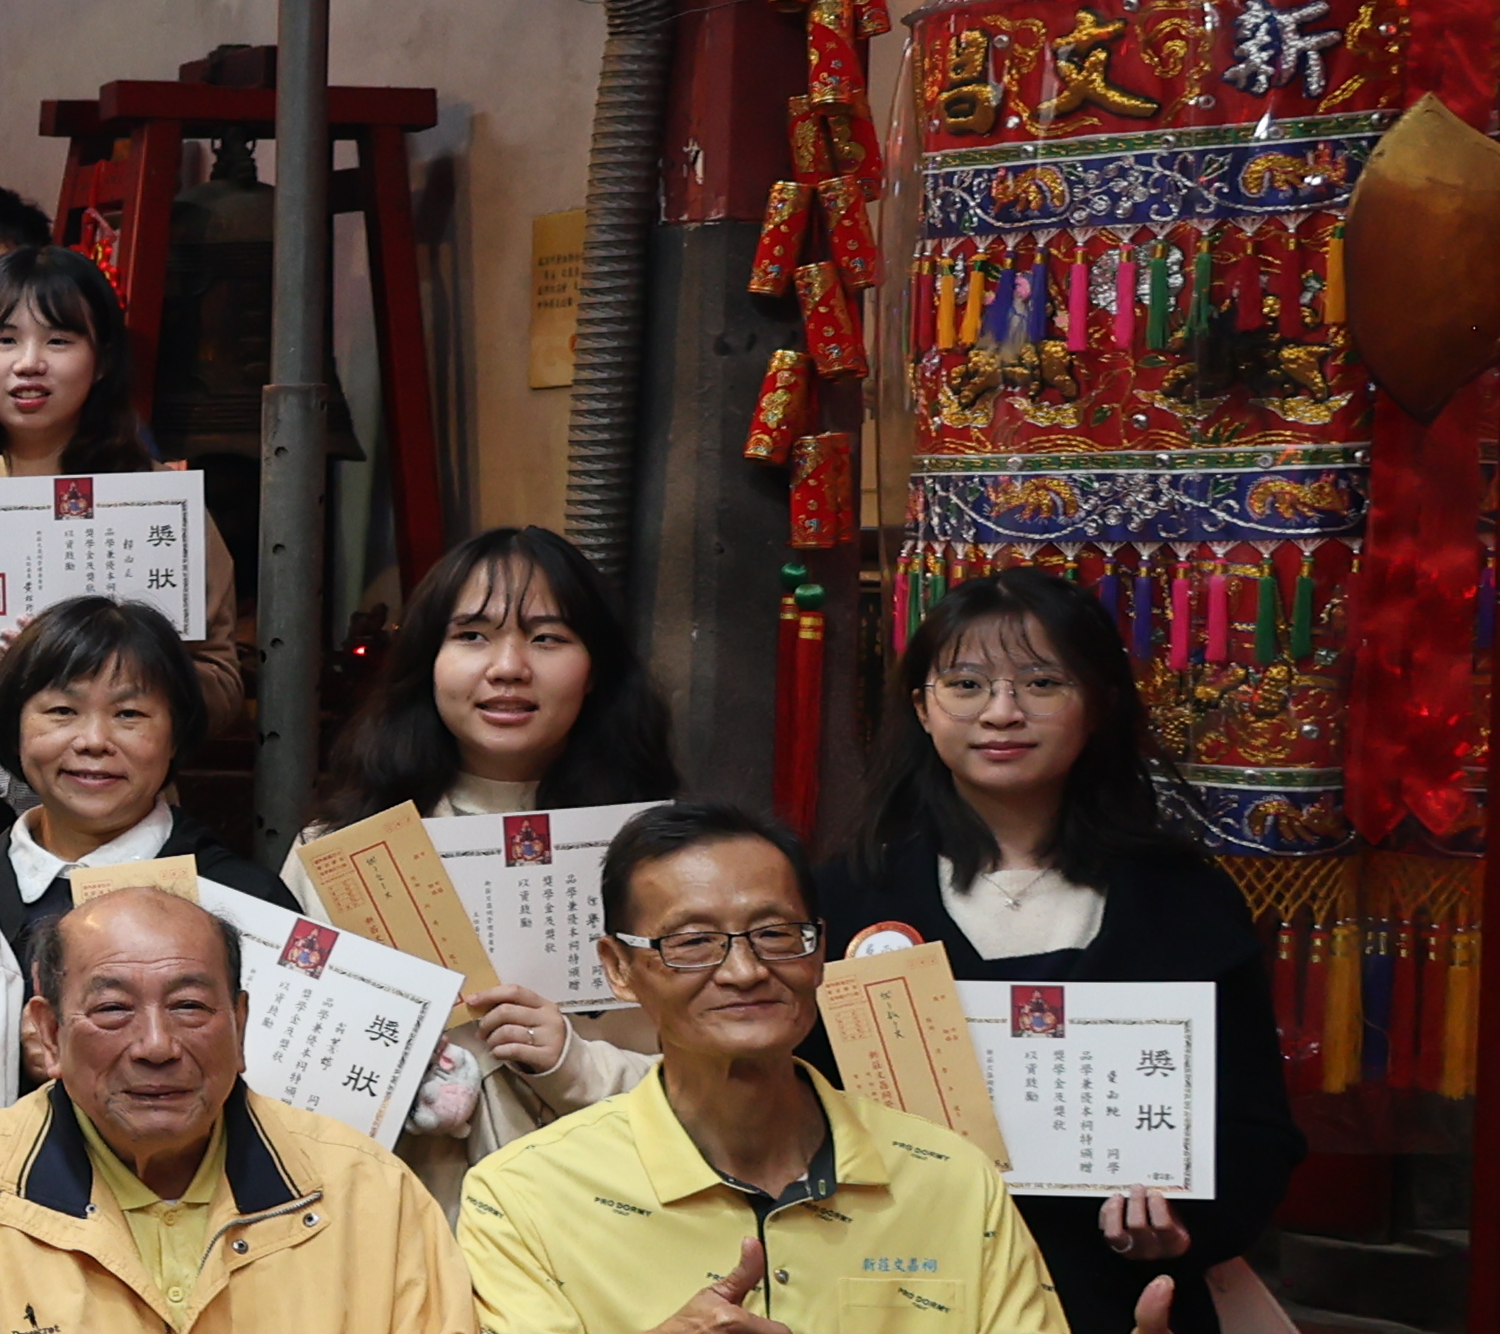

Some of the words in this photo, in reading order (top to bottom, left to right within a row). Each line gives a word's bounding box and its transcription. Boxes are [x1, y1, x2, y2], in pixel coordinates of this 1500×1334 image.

[146, 524, 178, 590] 獎狀
[340, 1013, 401, 1097] 獎狀
[1134, 1049, 1177, 1132] 獎狀
[1079, 1050, 1094, 1174] 品學兼優本祠特頒贈
